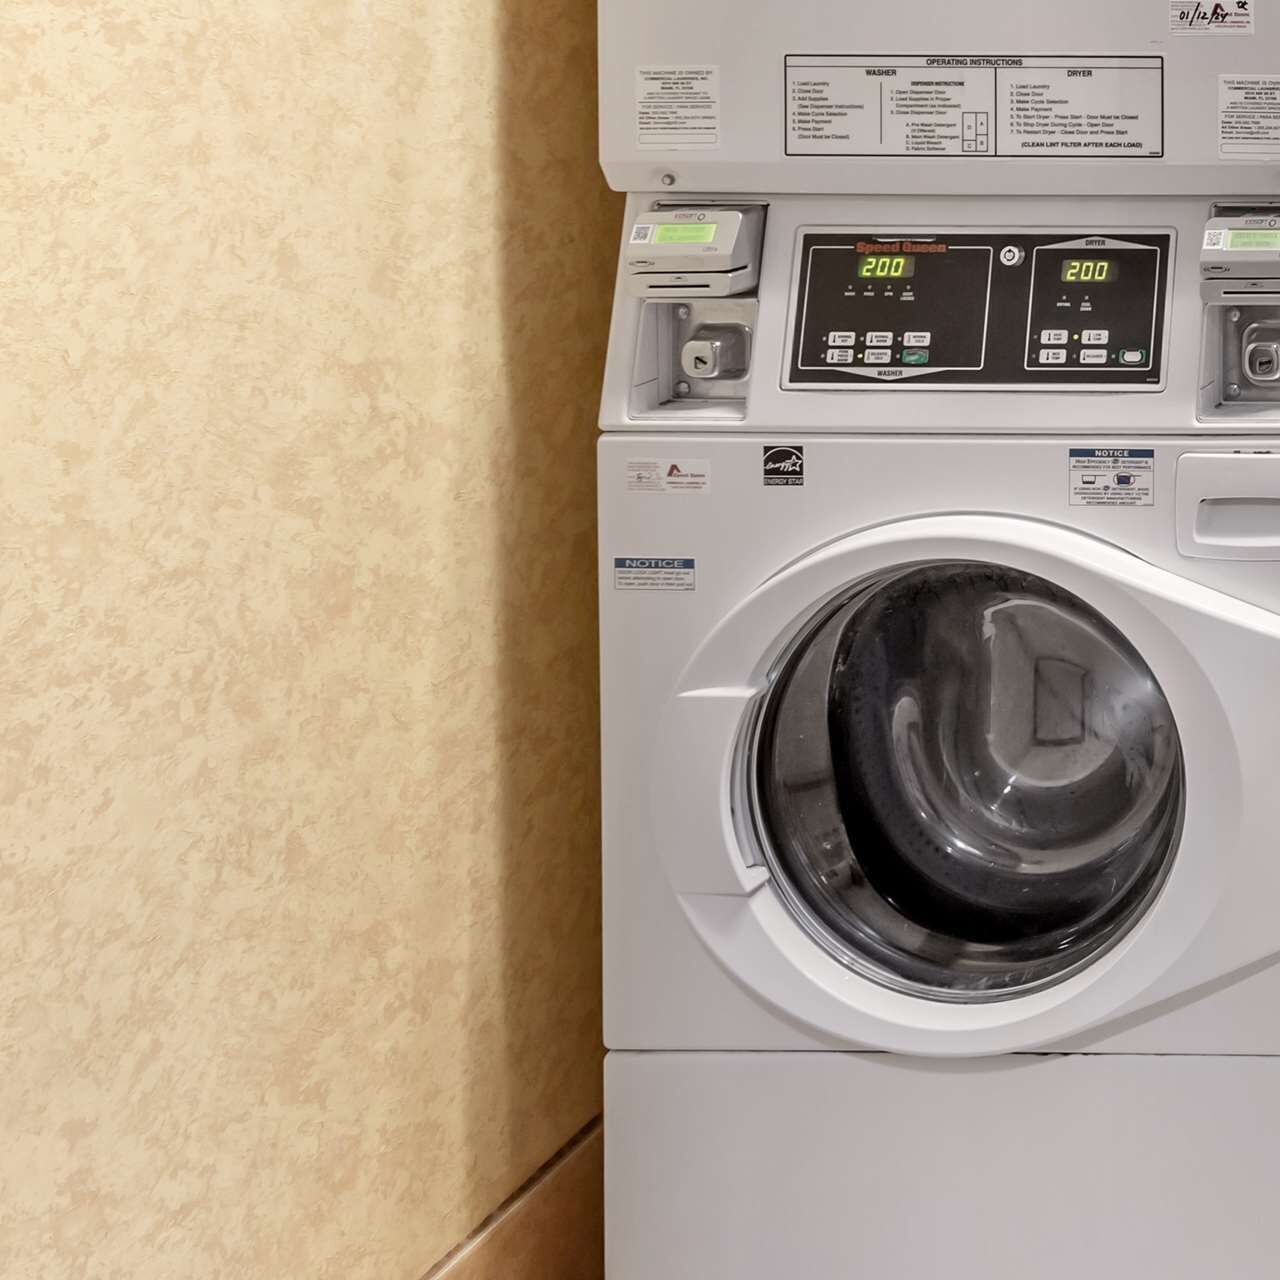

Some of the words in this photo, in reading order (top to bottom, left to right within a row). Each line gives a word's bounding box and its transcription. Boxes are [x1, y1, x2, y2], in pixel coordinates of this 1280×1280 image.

[856, 241, 900, 254] Speed
[902, 242, 947, 253] Queen
[862, 258, 905, 276] 200
[1066, 262, 1108, 280] 200
[625, 560, 685, 568] NOTICE
